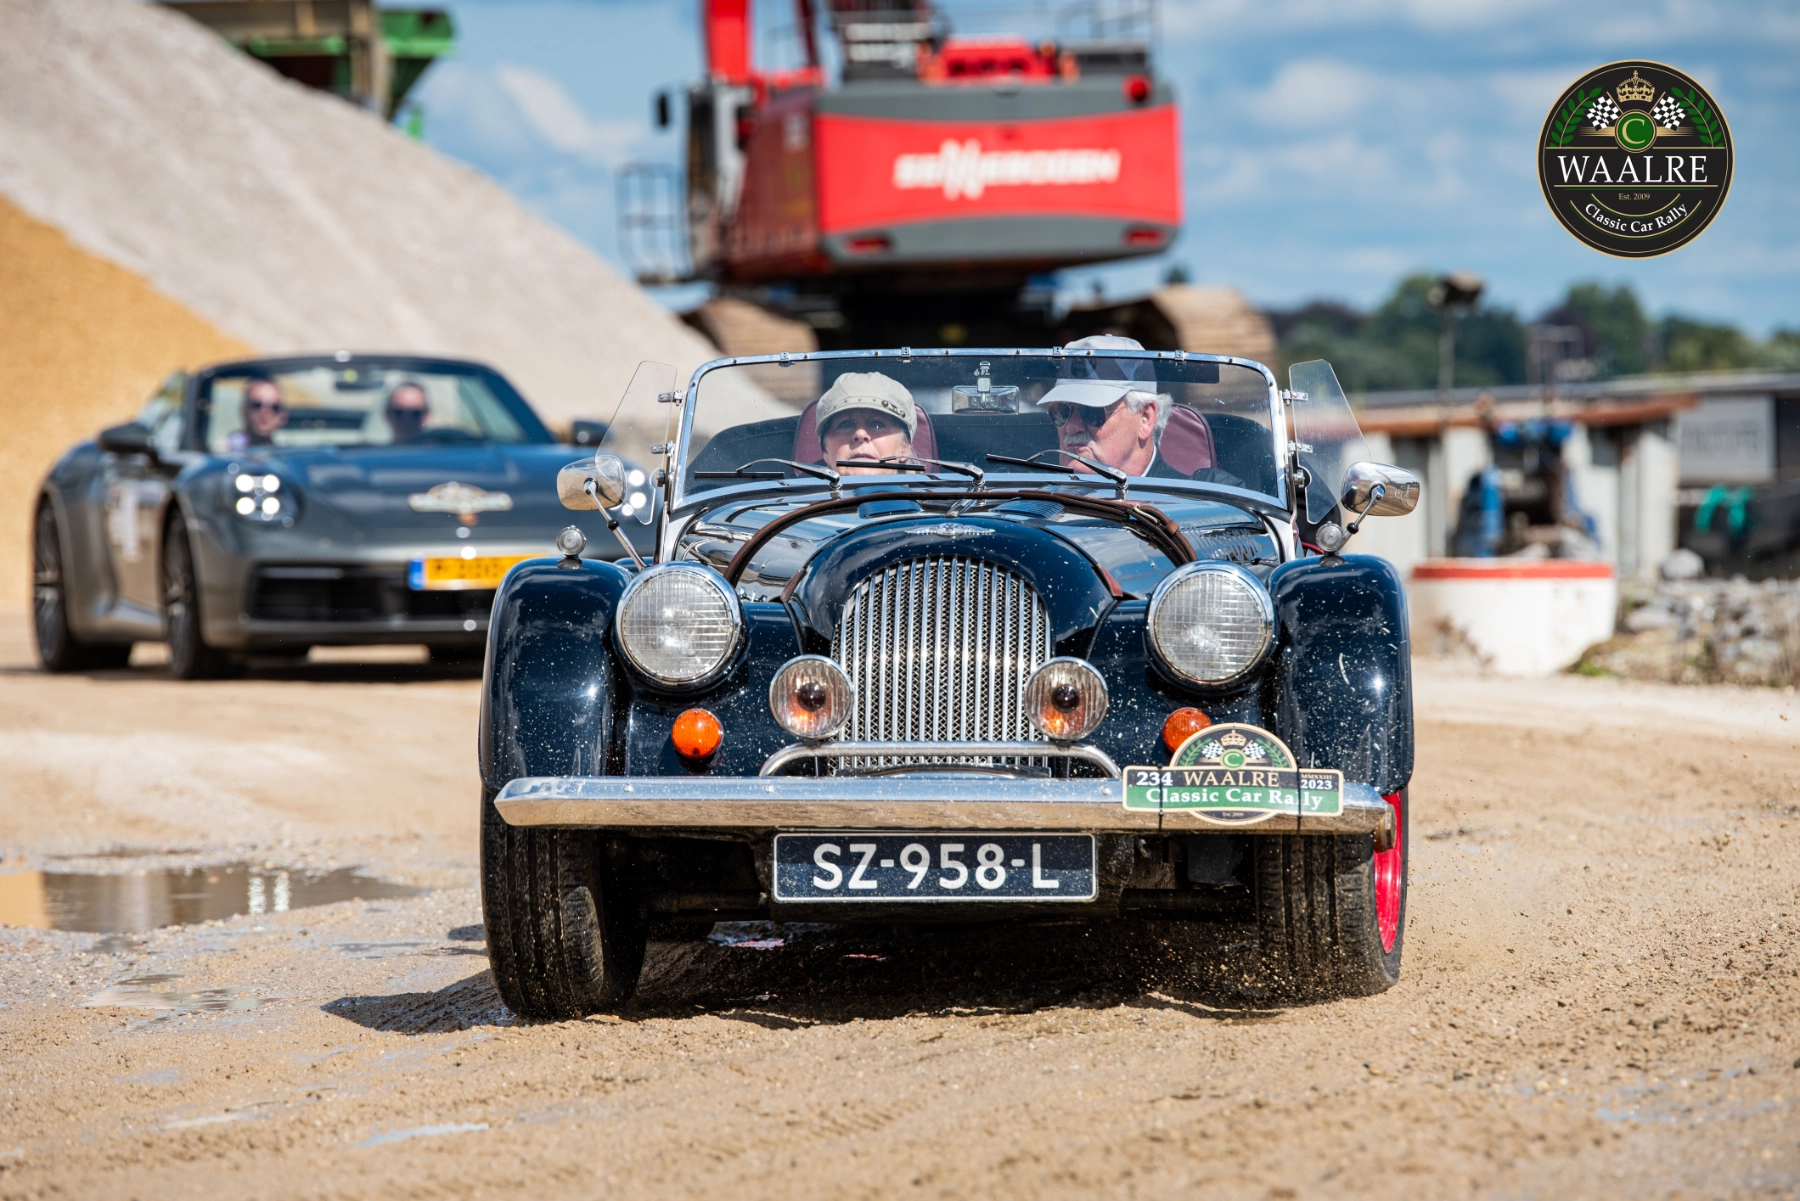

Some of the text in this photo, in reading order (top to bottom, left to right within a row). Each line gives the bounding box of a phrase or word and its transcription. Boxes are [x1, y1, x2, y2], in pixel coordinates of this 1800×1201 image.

[1136, 771, 1173, 786] 234
[1183, 771, 1279, 787] WAALRE
[1300, 779, 1333, 790] 2023
[1146, 788, 1219, 803] Classic
[1225, 788, 1262, 803] Car
[812, 843, 1060, 890] SZ-958-L
